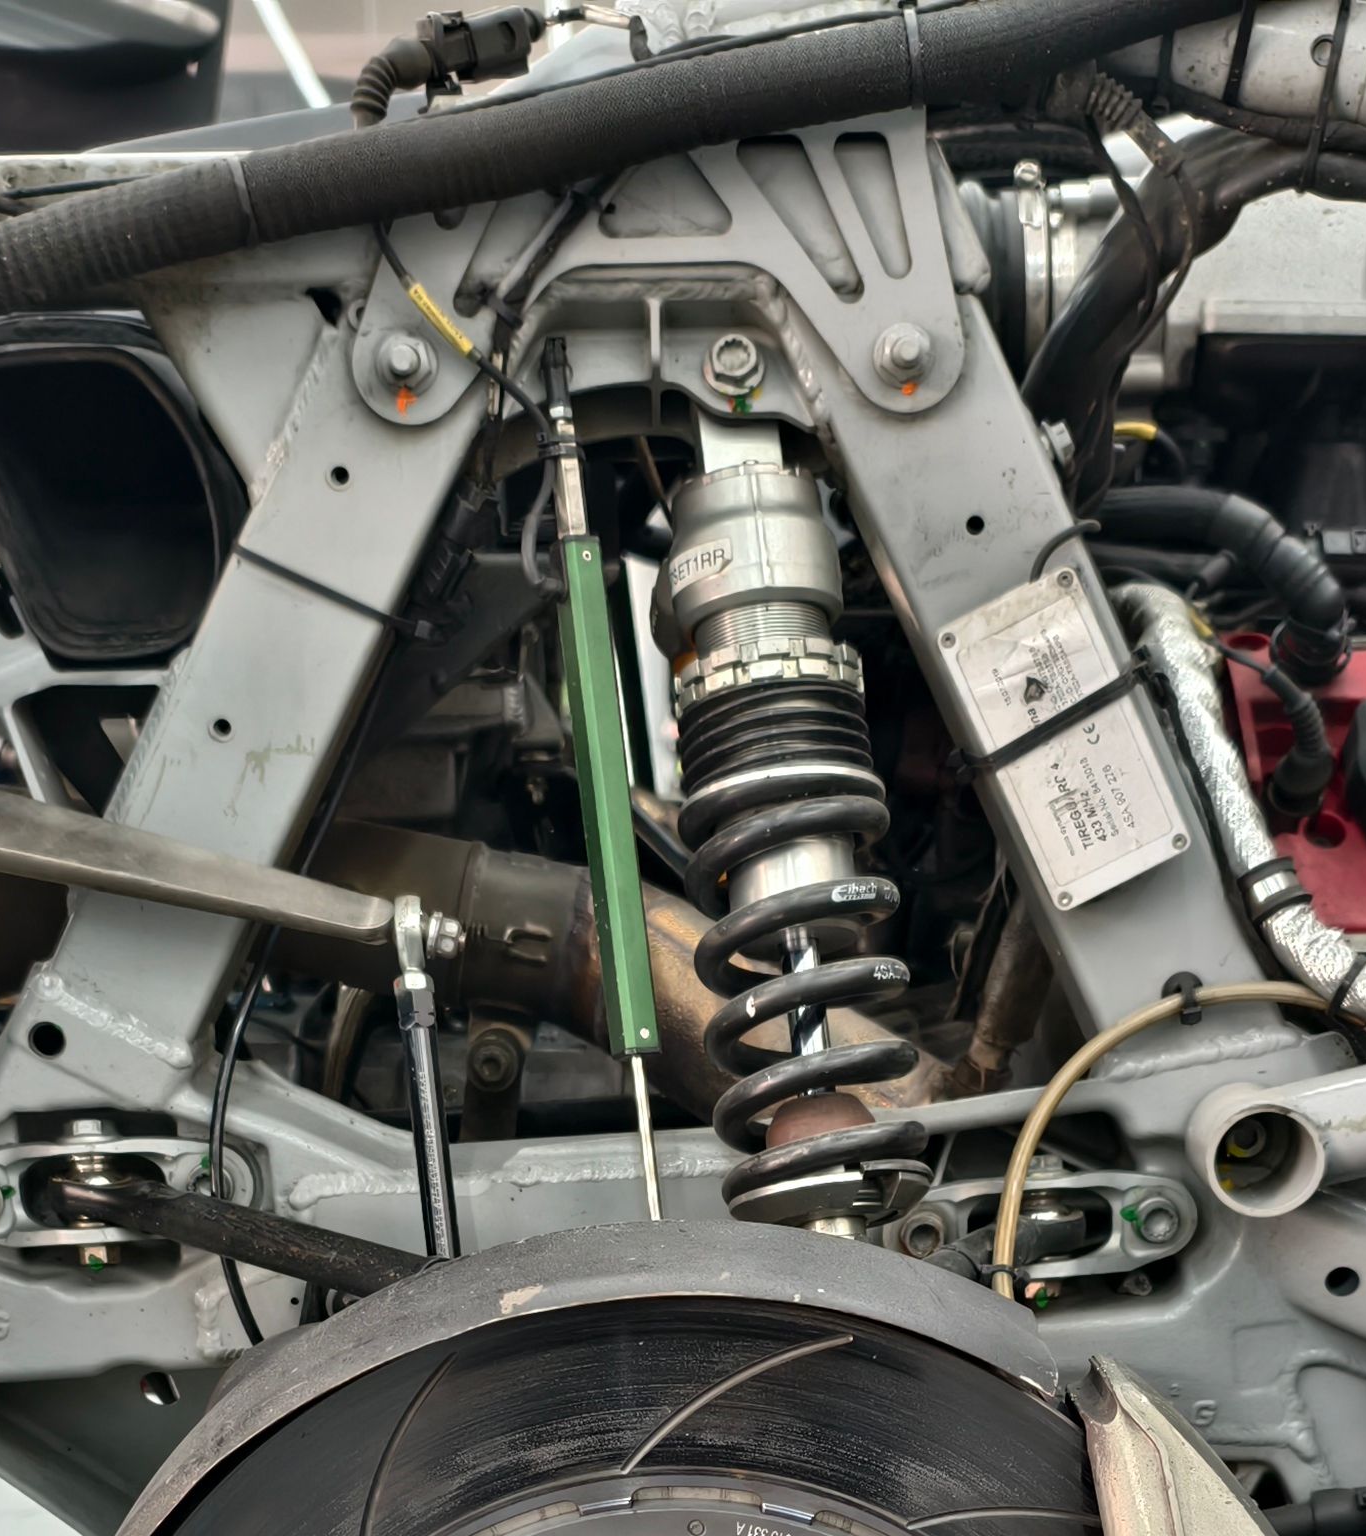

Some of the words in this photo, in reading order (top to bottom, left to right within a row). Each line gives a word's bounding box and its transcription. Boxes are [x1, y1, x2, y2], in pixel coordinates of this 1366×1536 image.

[1078, 790, 1098, 818] MHz
[1090, 819, 1108, 843] 433
[736, 1521, 746, 1536] A
